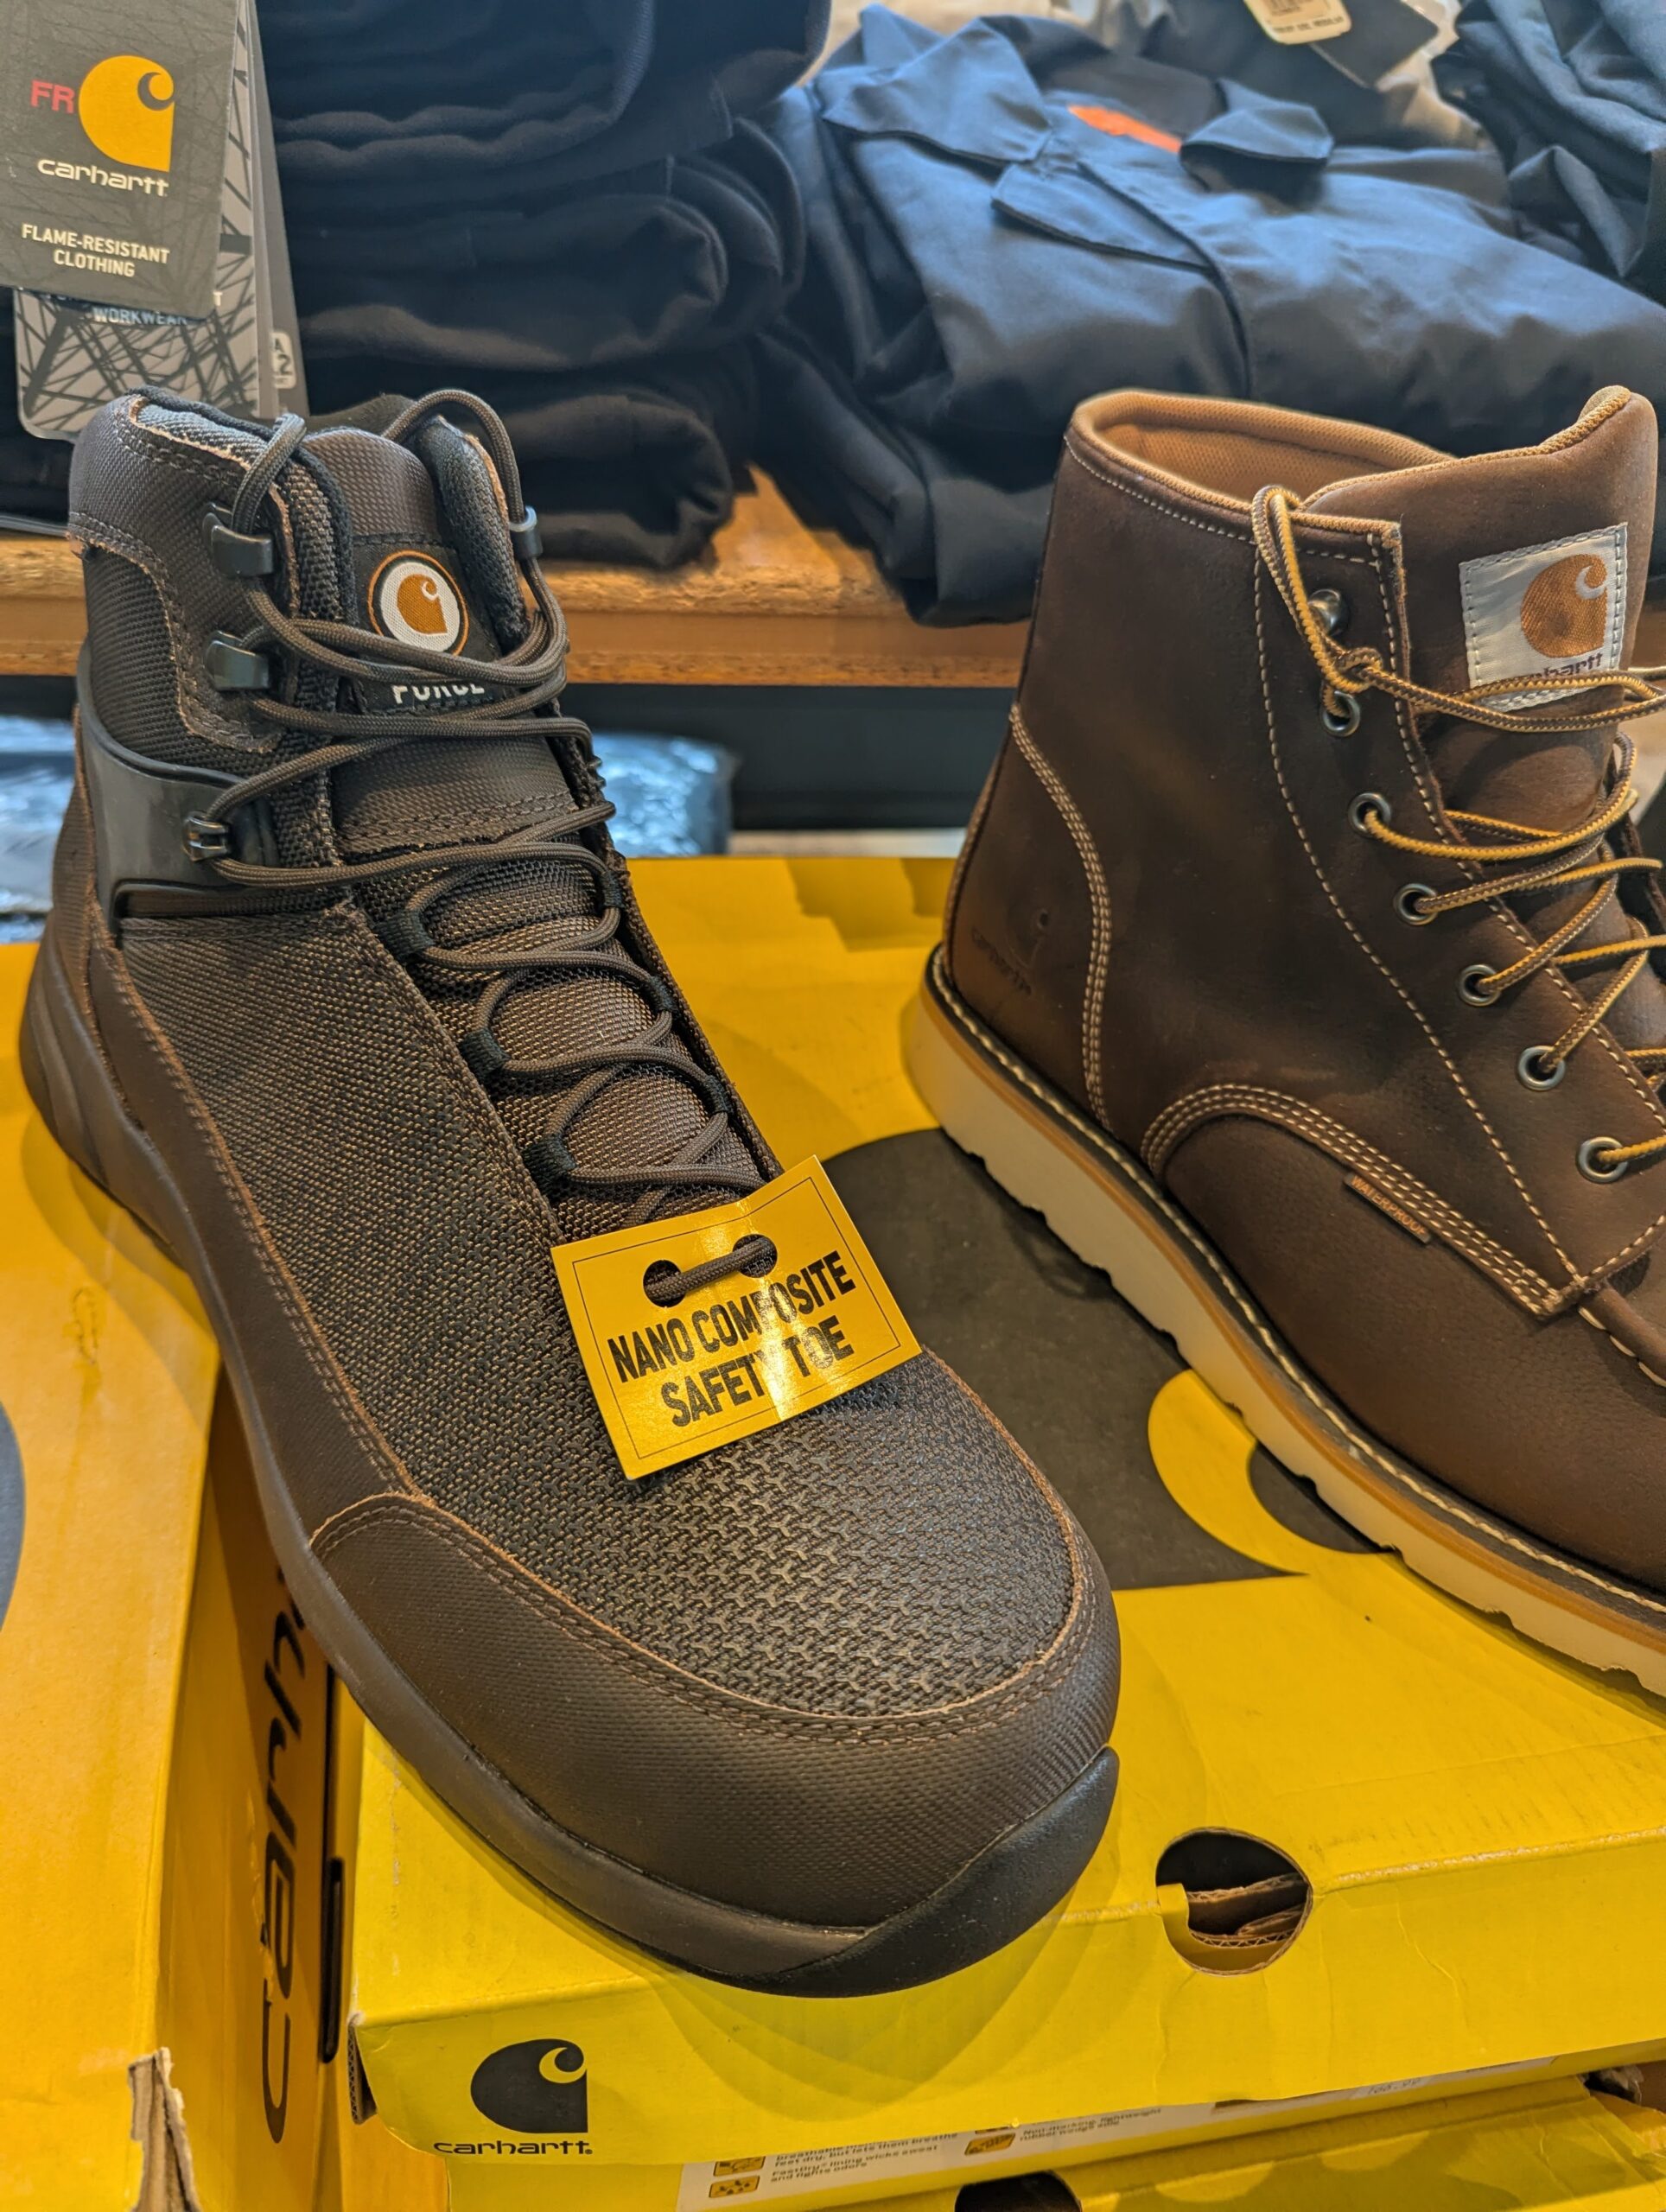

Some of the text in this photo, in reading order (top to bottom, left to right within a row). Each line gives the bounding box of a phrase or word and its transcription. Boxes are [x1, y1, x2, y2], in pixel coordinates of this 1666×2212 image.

[30, 79, 75, 114] FR
[37, 159, 169, 197] carhartt
[22, 223, 170, 264] FLAME-RESISTANT
[54, 249, 136, 277] CLOTHING
[1351, 1175, 1427, 1236] WATERPROOF
[607, 1318, 695, 1382] NANO
[782, 1315, 855, 1377] TOE
[263, 1567, 305, 2144] carh
